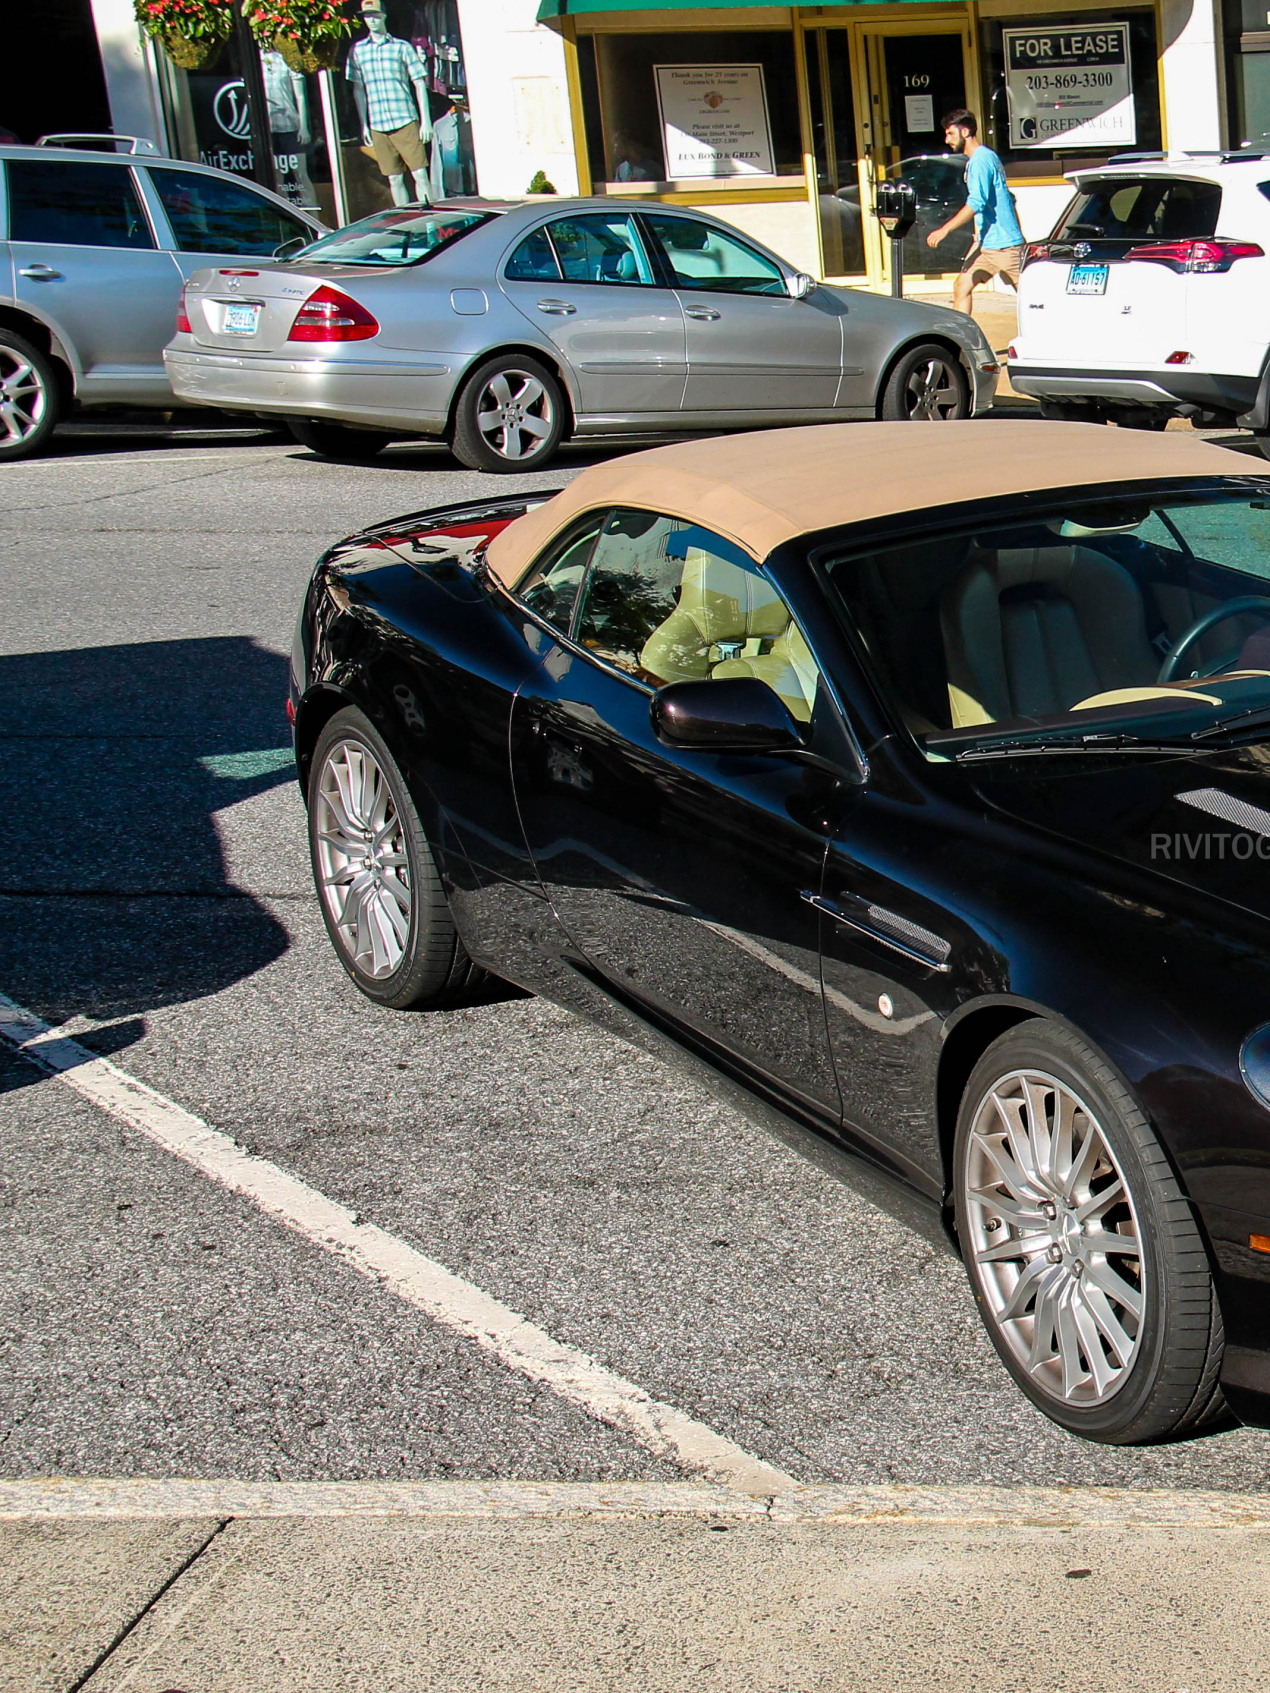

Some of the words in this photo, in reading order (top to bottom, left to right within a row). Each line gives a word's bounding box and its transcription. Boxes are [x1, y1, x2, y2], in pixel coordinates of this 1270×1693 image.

[1015, 39, 1053, 58] FOR
[1060, 34, 1119, 55] LEASE
[904, 74, 930, 88] 169
[1027, 72, 1113, 90] 203-869-3300
[1040, 116, 1123, 132] GREENWICH
[732, 151, 761, 159] GREEN
